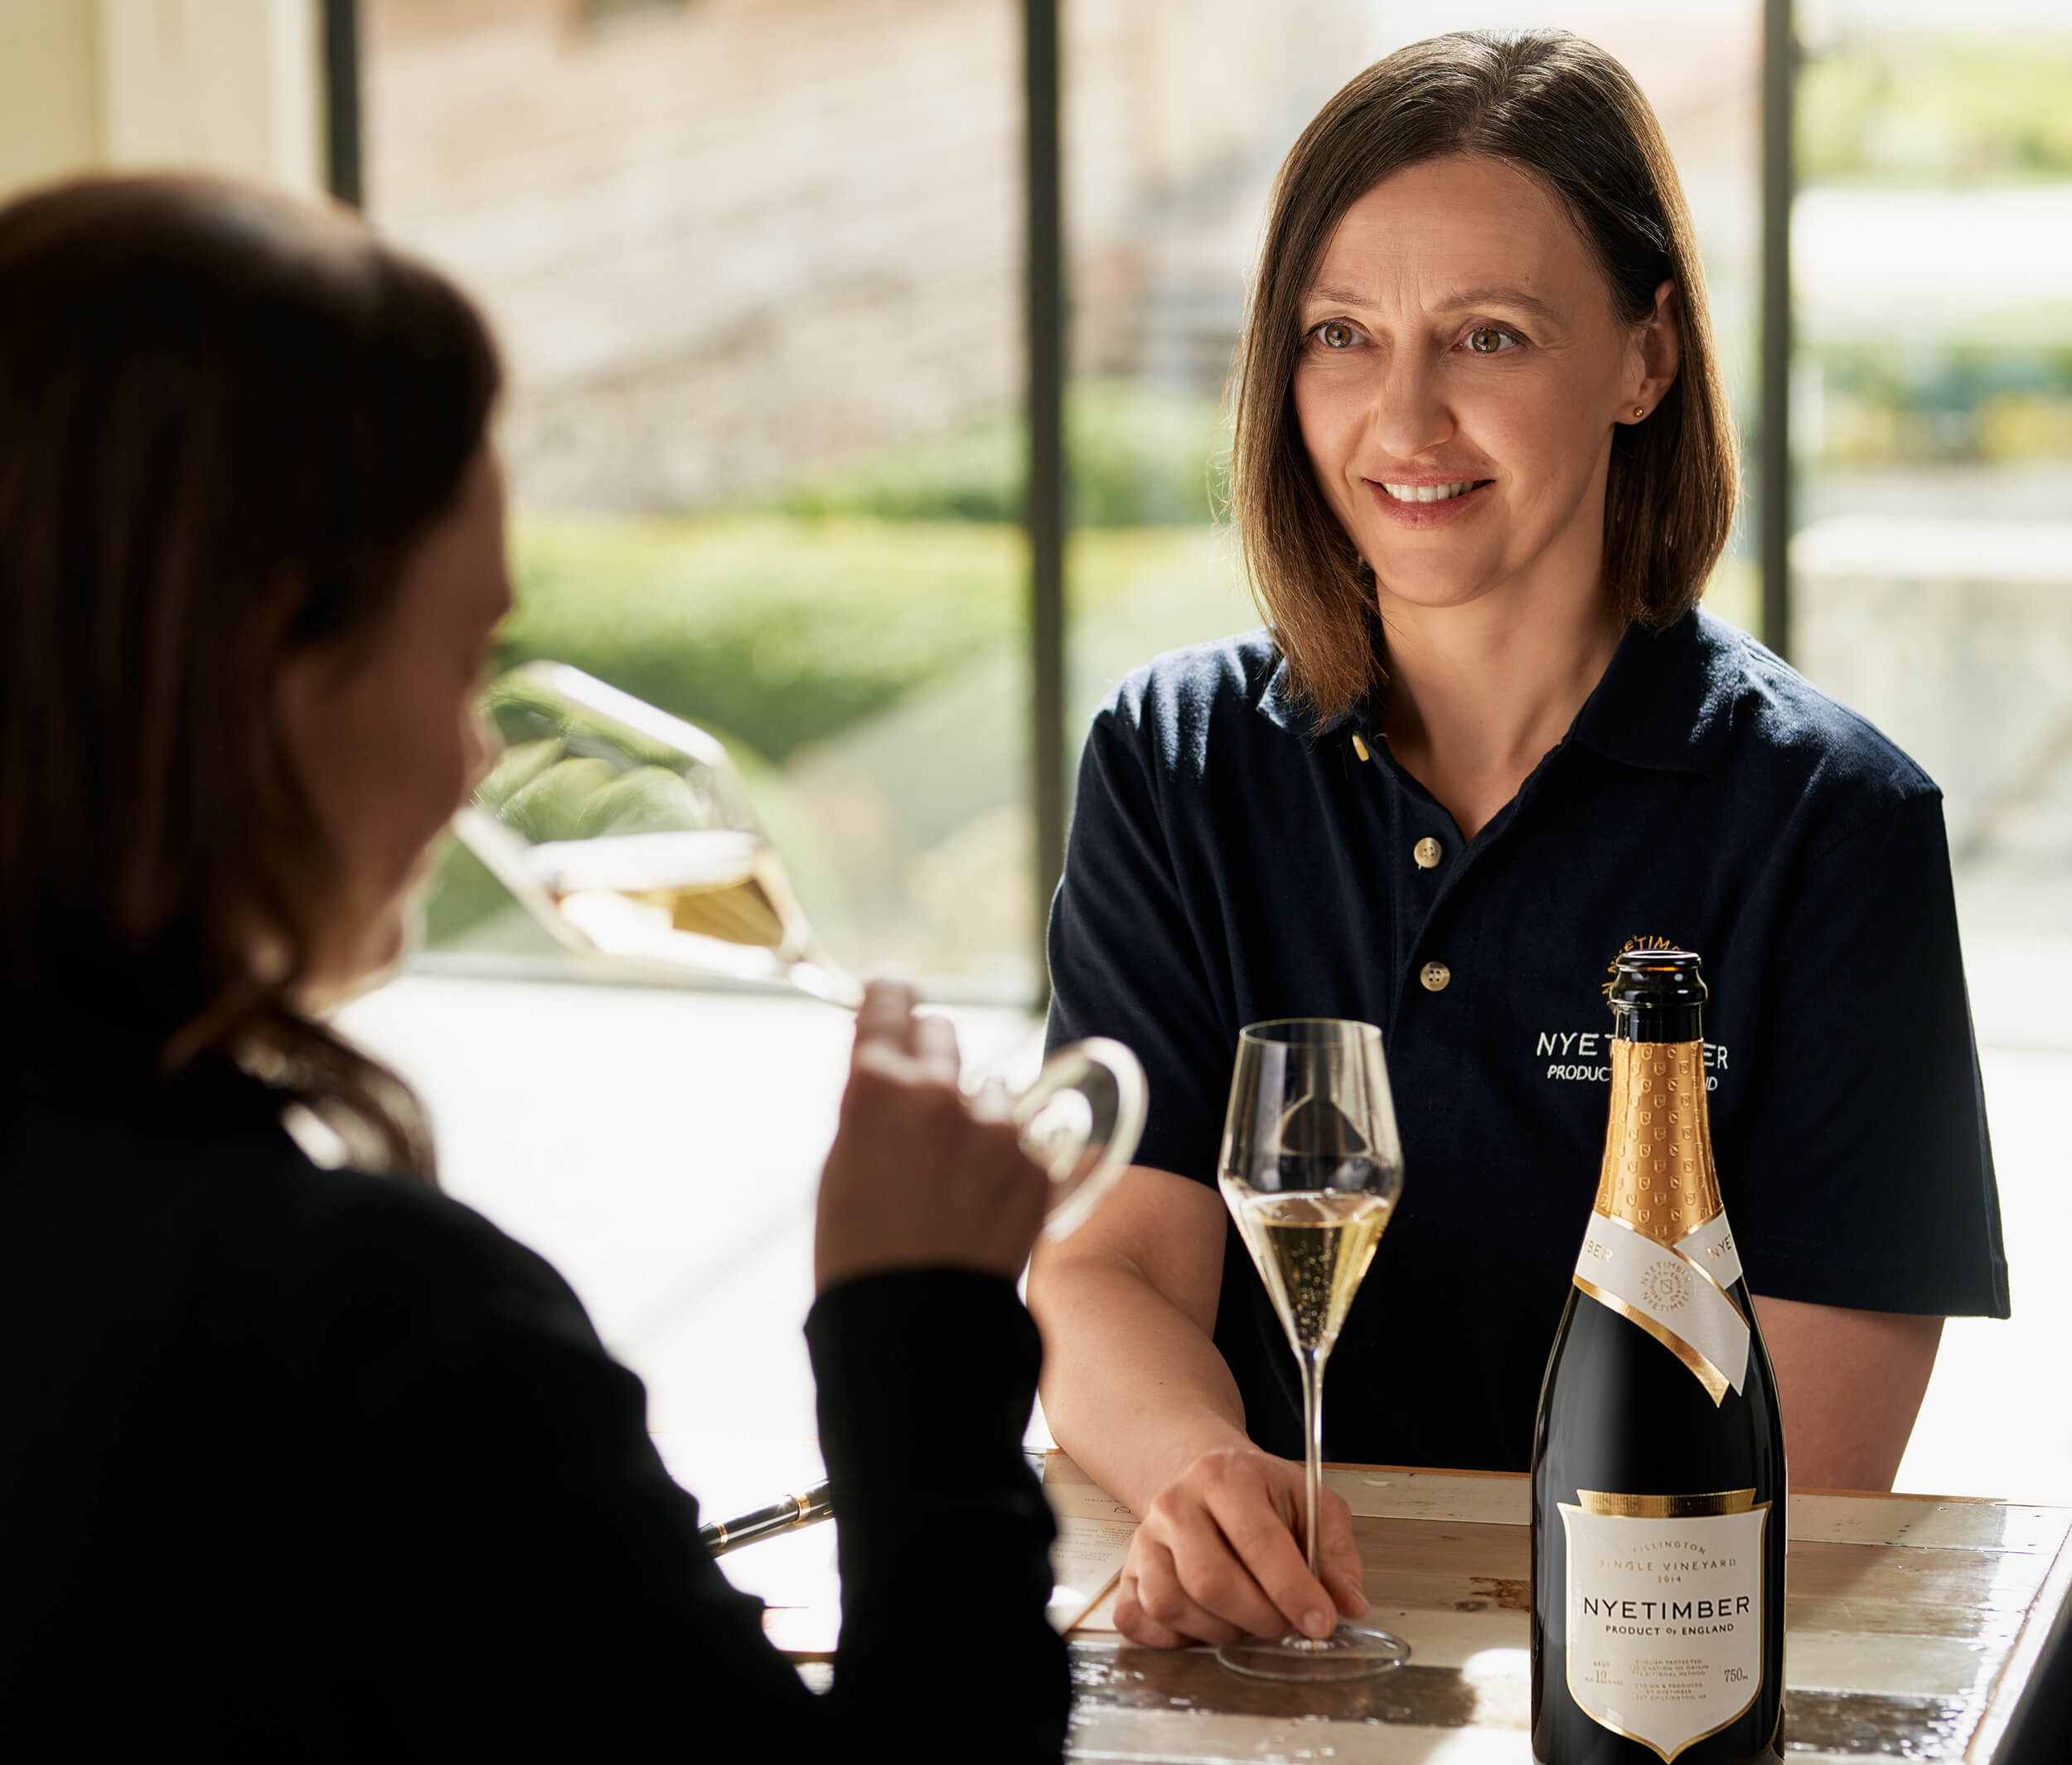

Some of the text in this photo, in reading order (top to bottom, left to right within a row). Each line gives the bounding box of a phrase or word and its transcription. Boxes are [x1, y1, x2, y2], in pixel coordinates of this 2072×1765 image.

[1547, 1064, 1613, 1082] PRODUC
[1585, 1239, 1614, 1263] BER
[1706, 1234, 1732, 1261] NYE
[1599, 1558, 1737, 1572] SINGLE VINEYARD
[1657, 1575, 1682, 1583] 2014
[1583, 1595, 1751, 1621] NYETIMBER
[1605, 1625, 1661, 1637] PRODUCT
[1682, 1623, 1735, 1637] ENGLAND
